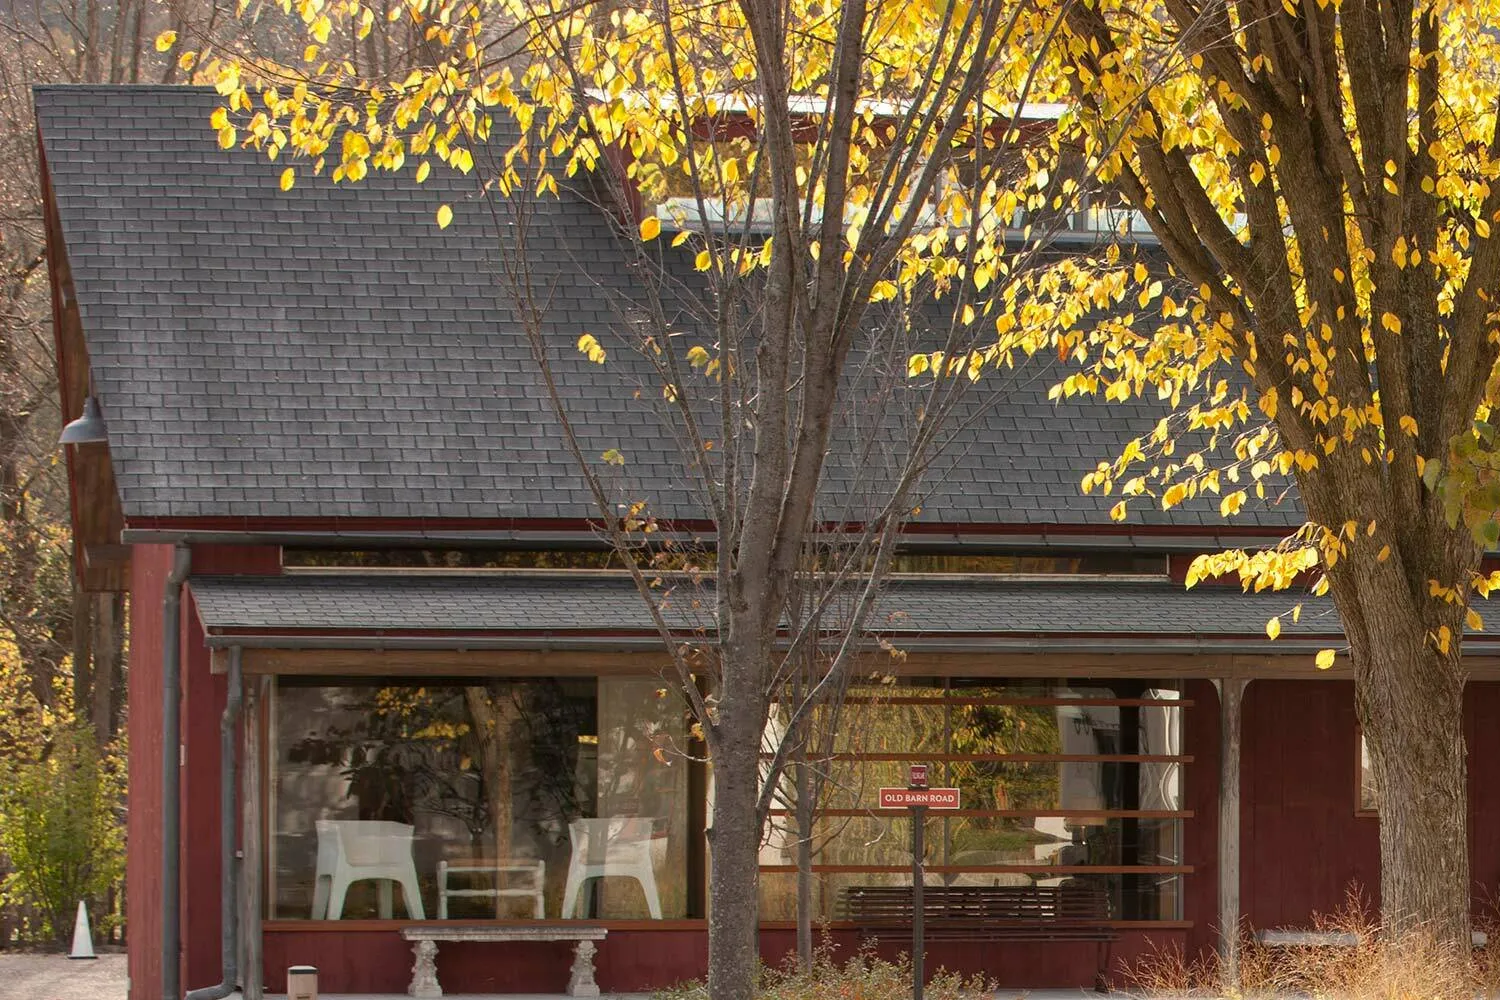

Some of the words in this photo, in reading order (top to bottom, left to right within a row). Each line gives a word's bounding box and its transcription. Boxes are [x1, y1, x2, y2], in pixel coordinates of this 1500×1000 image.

[884, 794, 904, 802] OLD
[905, 794, 928, 803] BARN
[930, 794, 955, 803] ROAD
